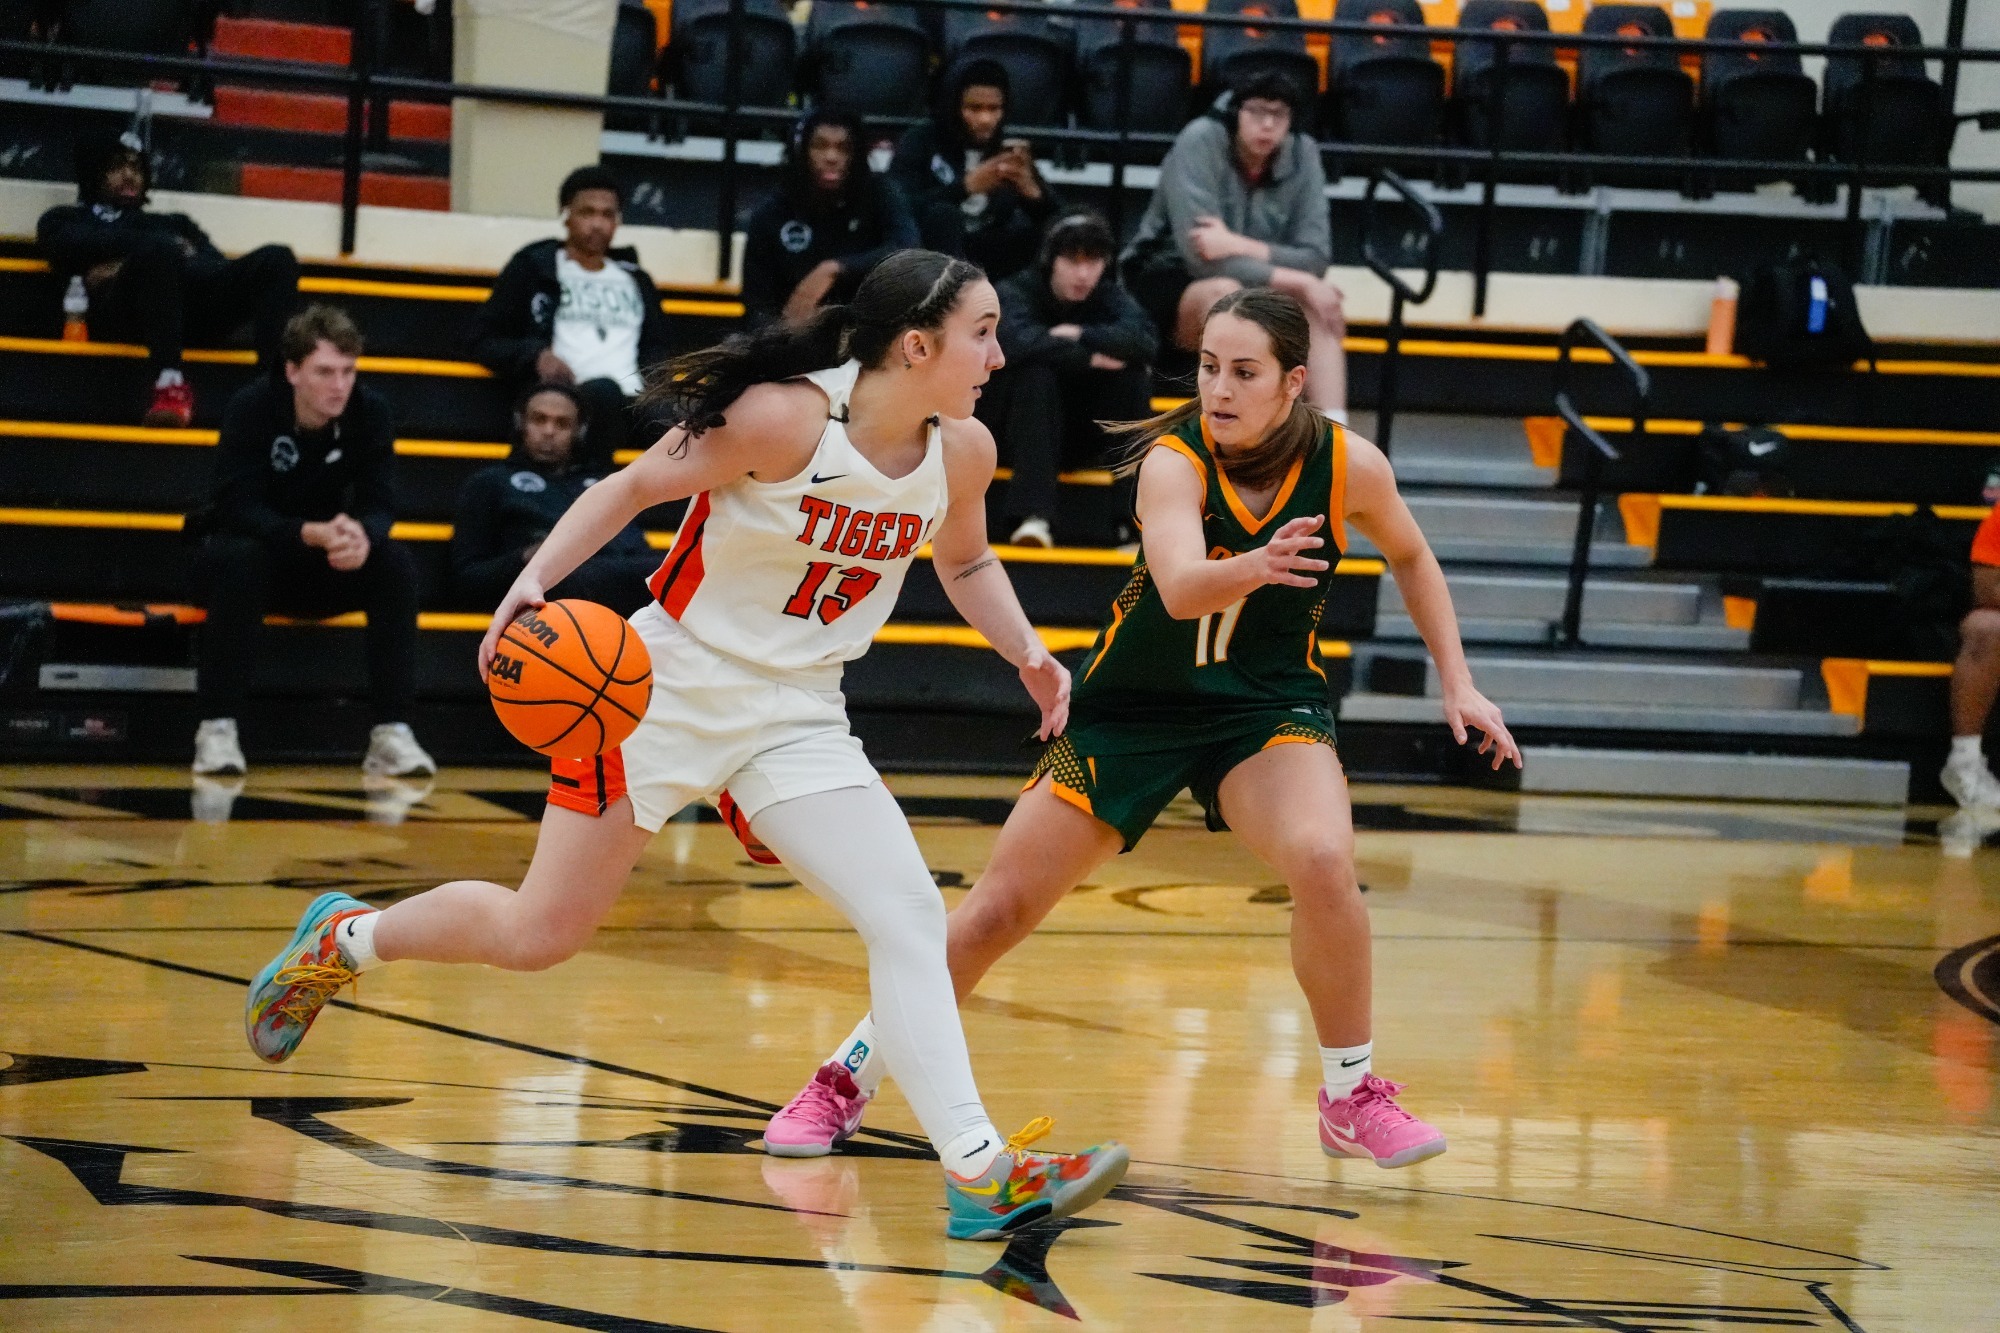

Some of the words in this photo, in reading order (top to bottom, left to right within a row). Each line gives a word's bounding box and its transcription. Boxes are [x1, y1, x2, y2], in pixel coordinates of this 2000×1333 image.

[796, 494, 933, 560] TIGER
[782, 561, 881, 626] 13
[488, 652, 524, 684] CAA
